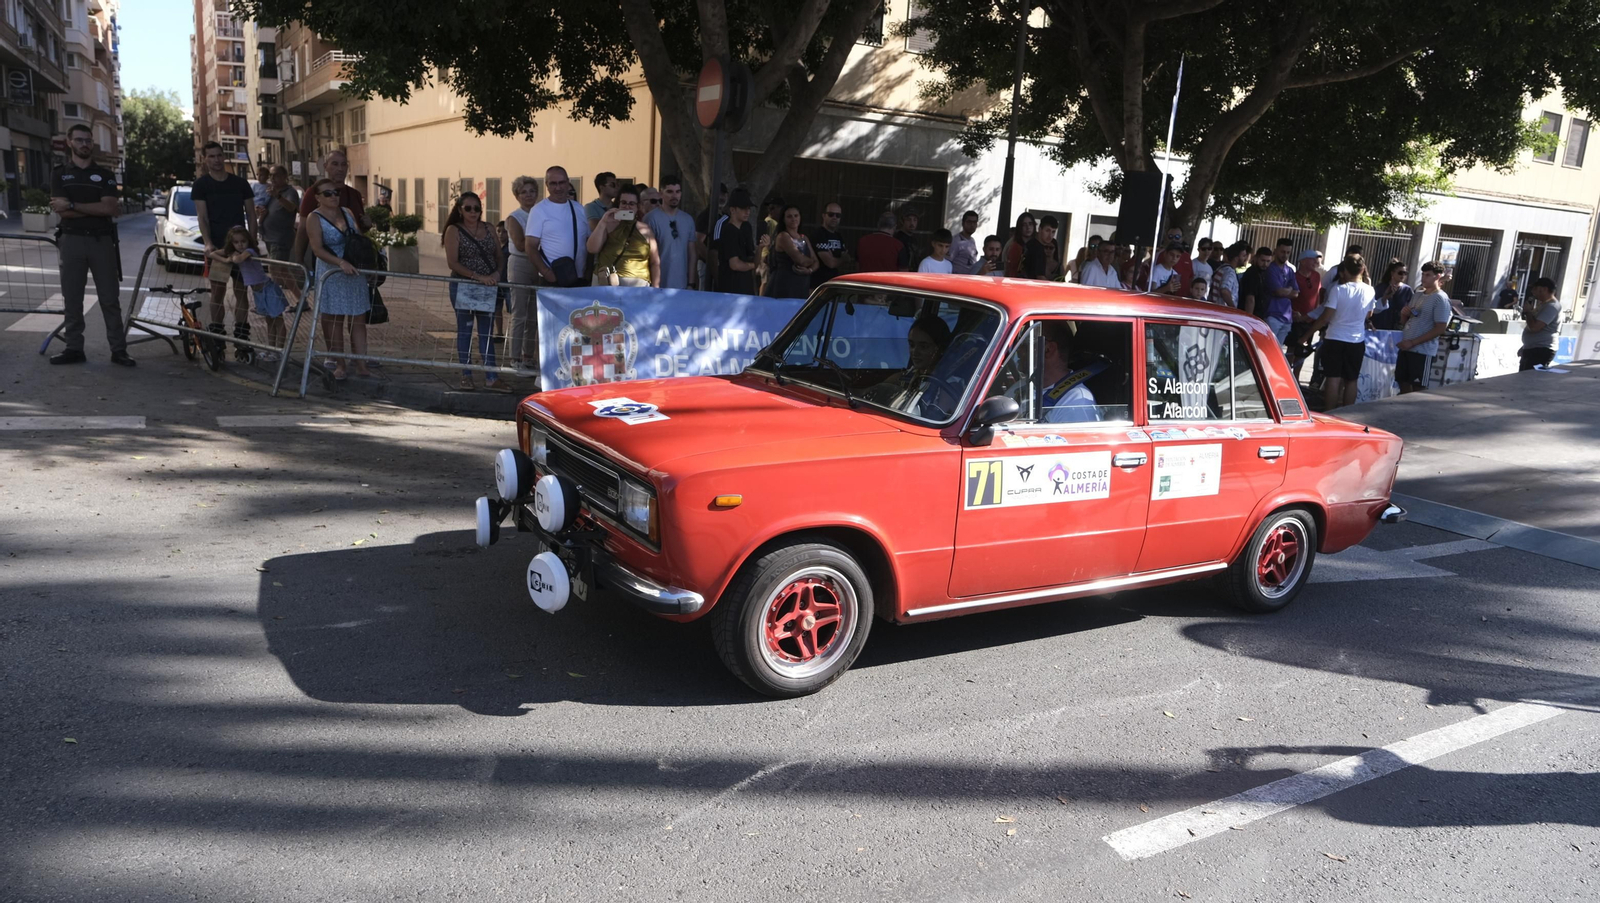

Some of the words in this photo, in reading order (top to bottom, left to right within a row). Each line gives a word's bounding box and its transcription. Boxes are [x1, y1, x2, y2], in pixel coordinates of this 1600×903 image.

[655, 354, 690, 377] DE
[1148, 377, 1161, 394] S.
[1163, 377, 1208, 394] Alarcón
[1149, 402, 1161, 418] L.
[1163, 402, 1208, 418] Alarcón
[1071, 470, 1097, 480] COSTA
[1098, 469, 1108, 478] DE
[968, 460, 1002, 506] 71
[1007, 487, 1042, 495] CUPRA
[1063, 479, 1108, 495] ALMERÍA
